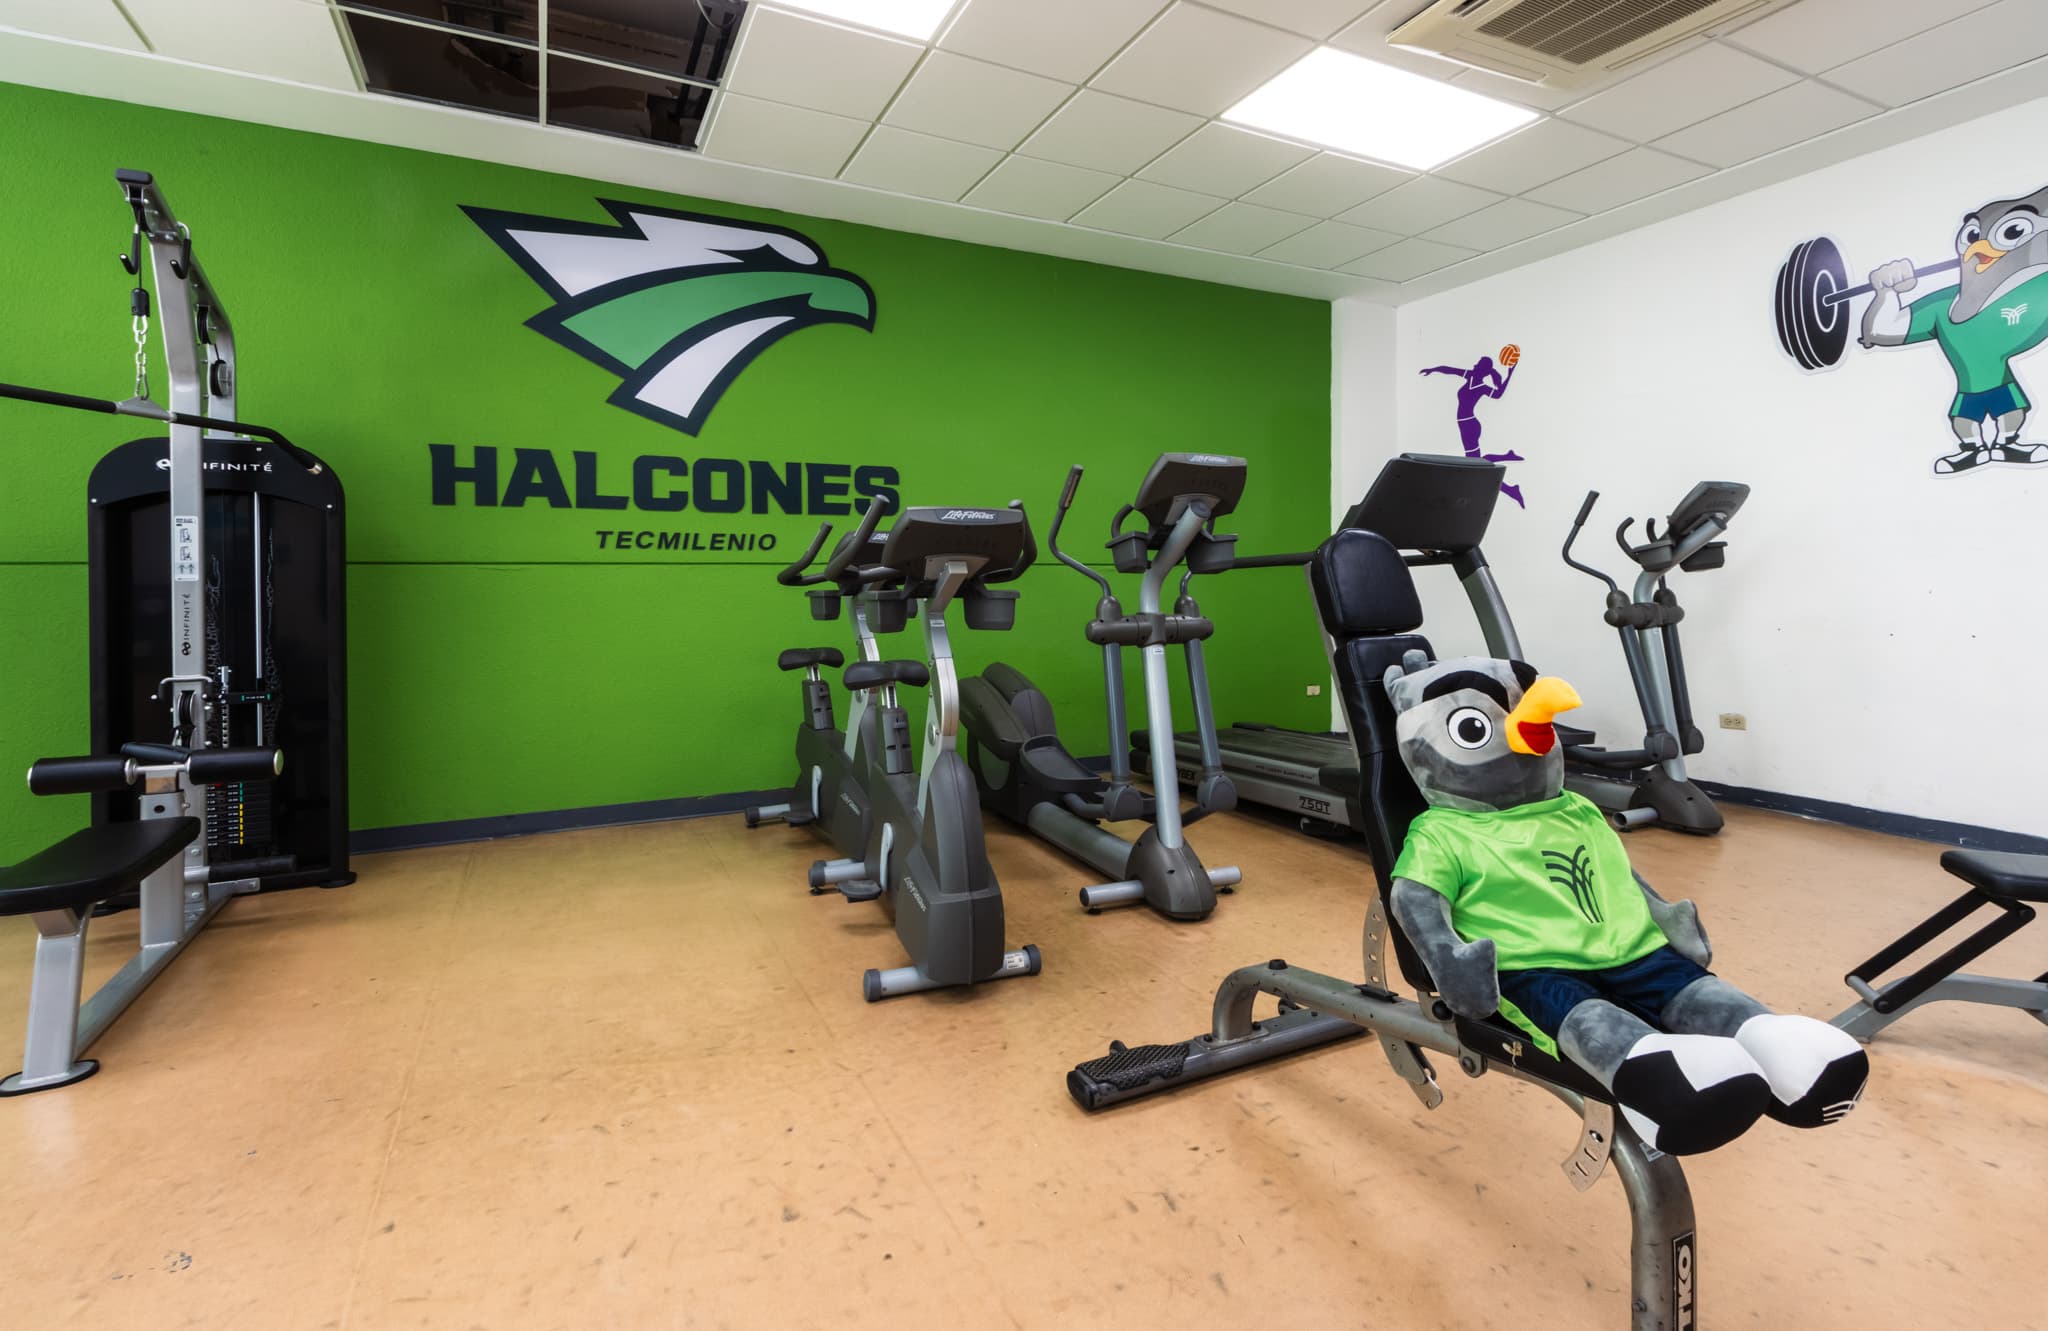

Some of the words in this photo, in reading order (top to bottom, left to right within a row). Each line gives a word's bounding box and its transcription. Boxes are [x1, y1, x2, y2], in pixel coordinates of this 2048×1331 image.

[203, 461, 273, 472] FINITÉ
[429, 444, 899, 517] HALCONES
[596, 530, 777, 551] TECMILENIO
[181, 593, 191, 641] INFINITÉ
